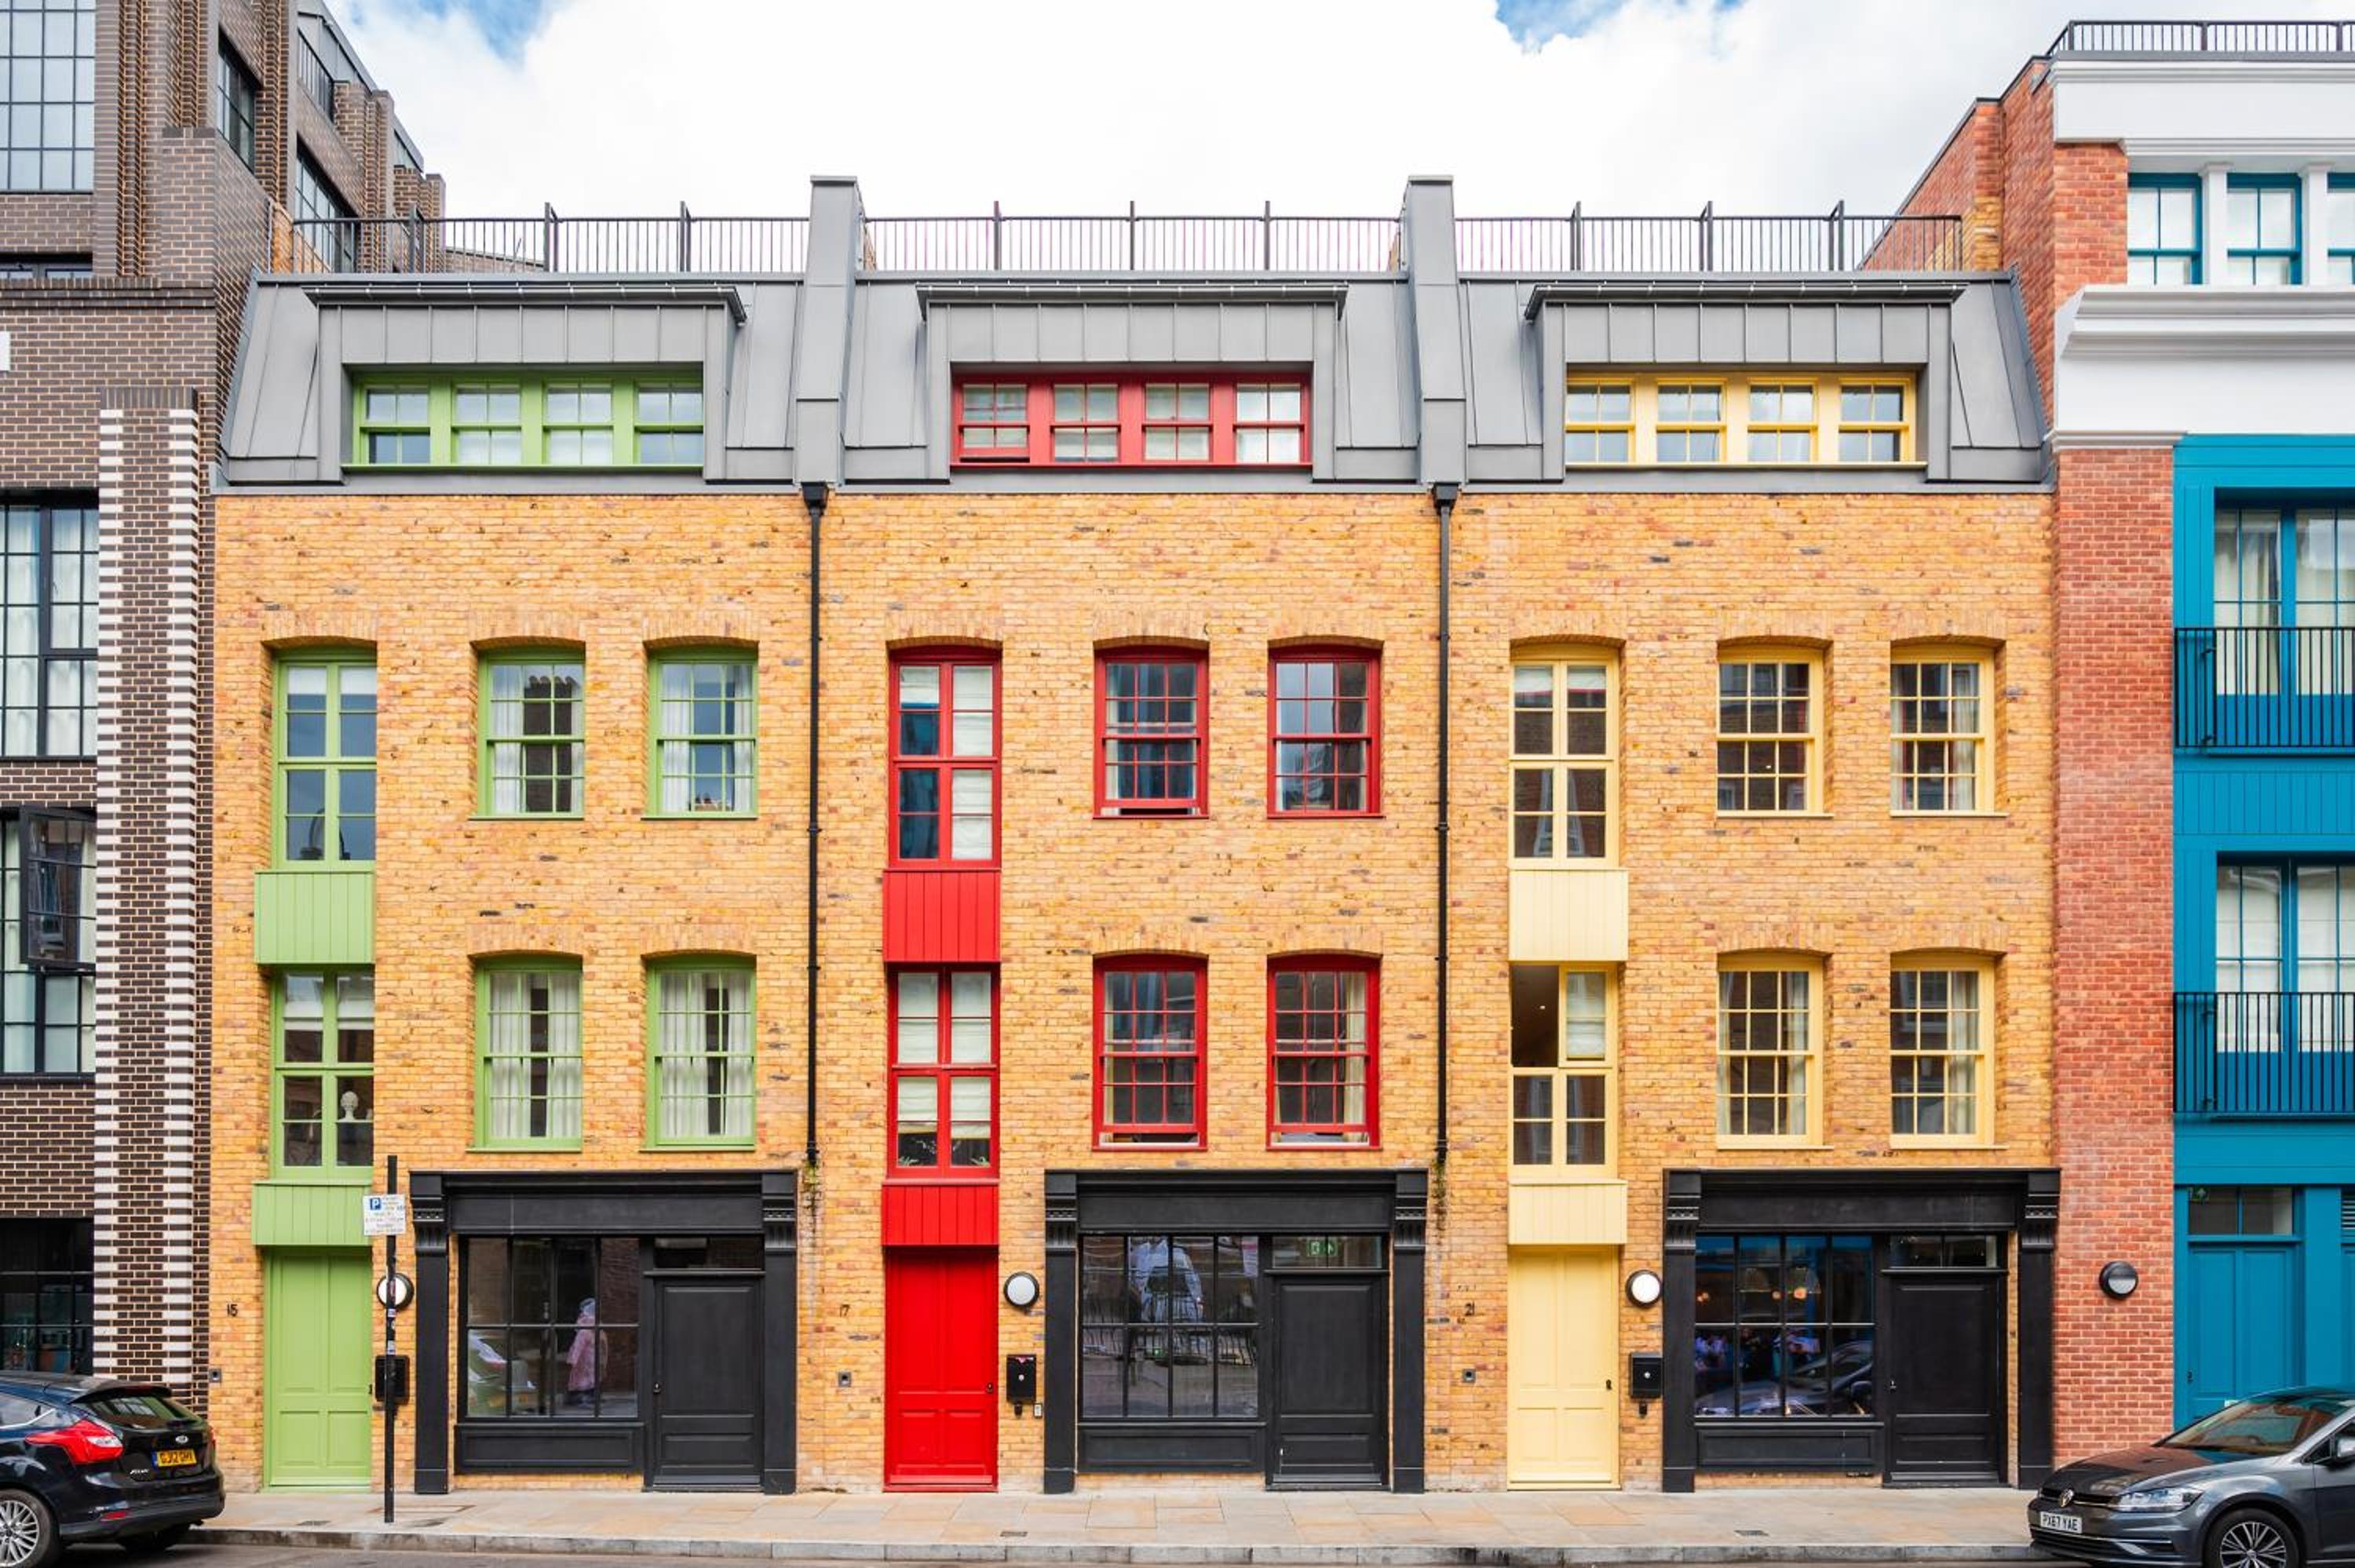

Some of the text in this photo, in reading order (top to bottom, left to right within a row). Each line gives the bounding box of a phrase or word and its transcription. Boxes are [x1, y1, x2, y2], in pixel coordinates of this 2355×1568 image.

[227, 1304, 239, 1317] 15
[839, 1304, 850, 1318] 17
[1465, 1302, 1475, 1317] 21
